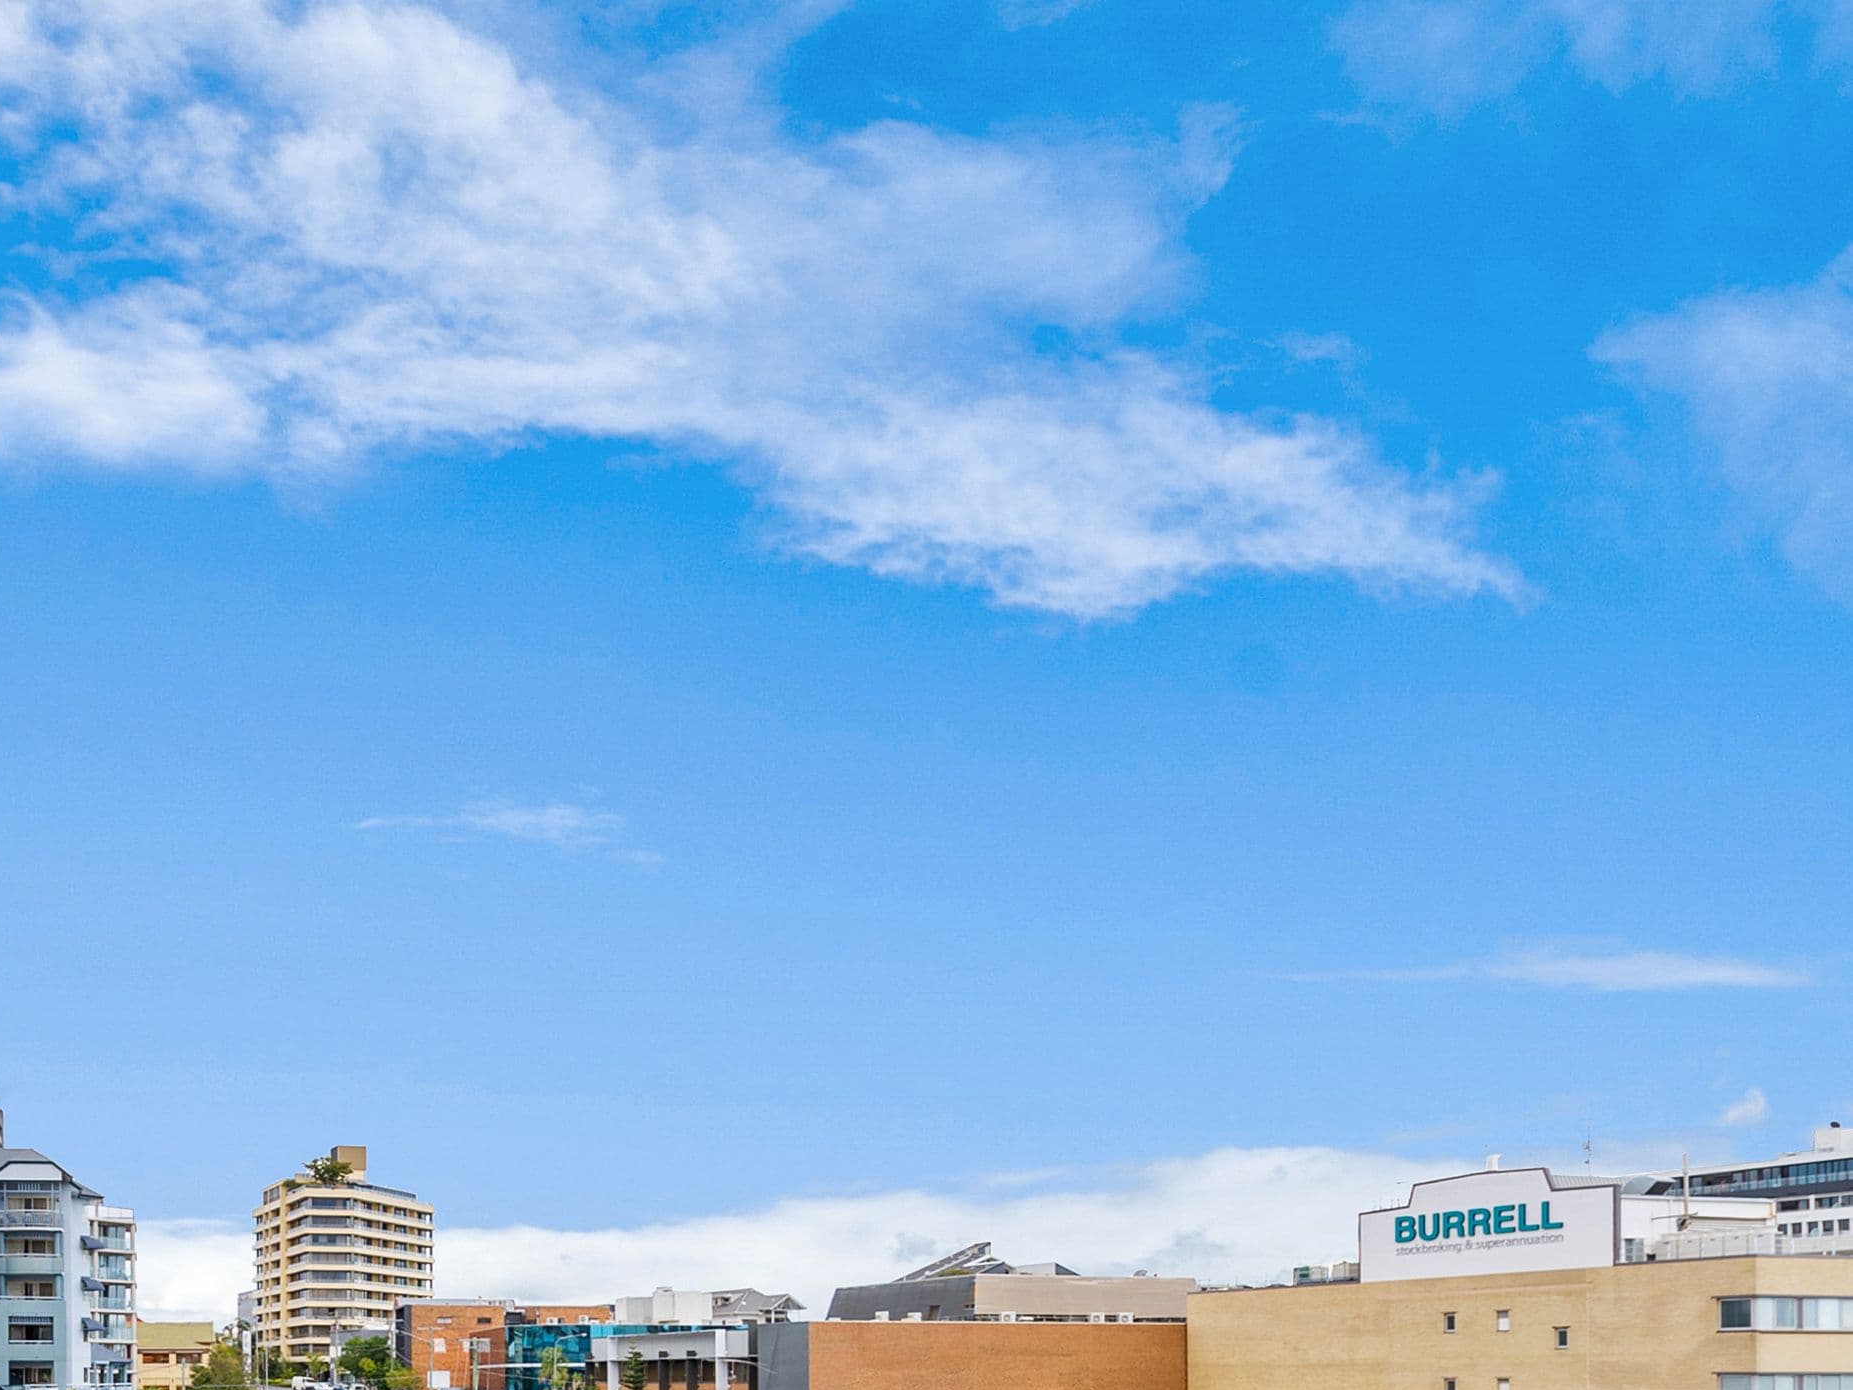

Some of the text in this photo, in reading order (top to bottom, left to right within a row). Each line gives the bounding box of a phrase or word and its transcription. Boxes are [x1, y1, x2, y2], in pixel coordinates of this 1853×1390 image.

[1394, 1200, 1564, 1244] BURRELL
[1396, 1233, 1564, 1257] stockbroking & superannuation
